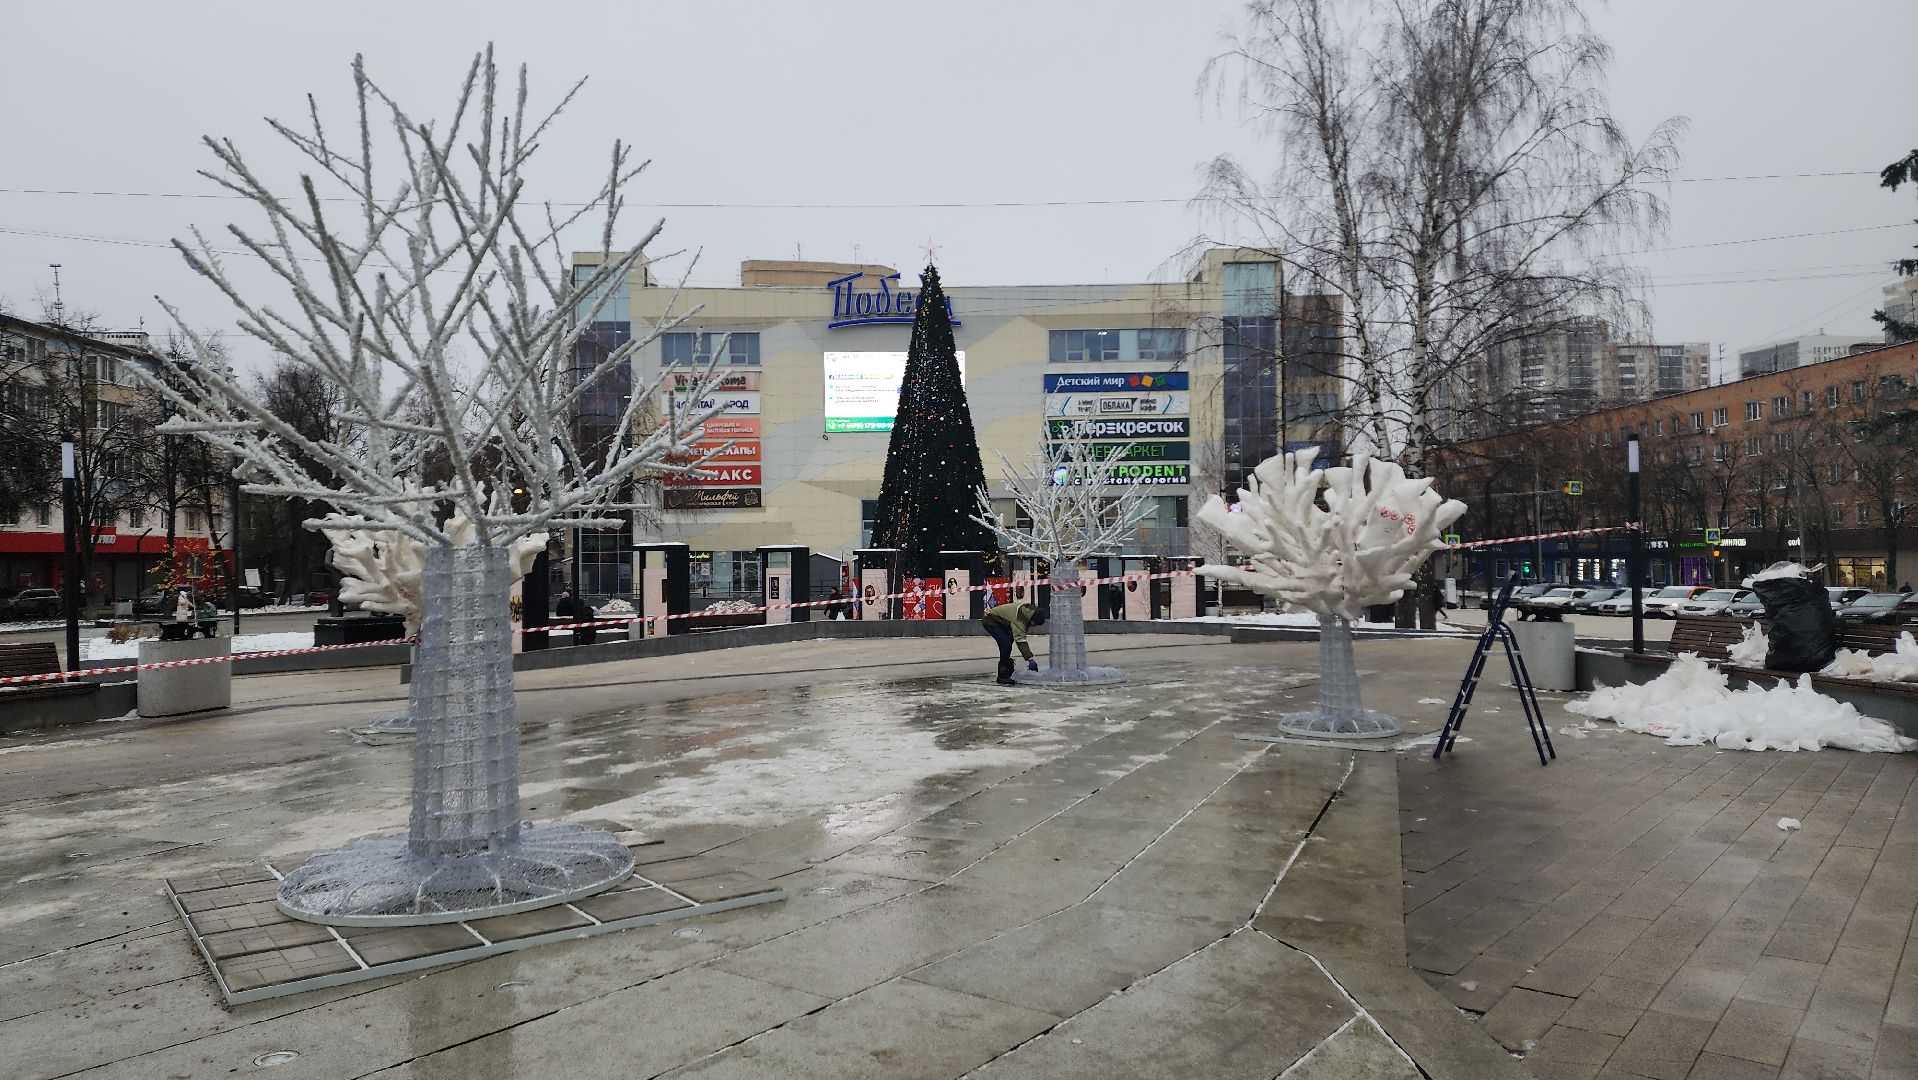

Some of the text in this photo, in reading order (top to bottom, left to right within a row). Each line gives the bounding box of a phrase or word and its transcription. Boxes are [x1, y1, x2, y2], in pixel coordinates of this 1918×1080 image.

[827, 272, 954, 318] Побе
[1057, 376, 1126, 388] Детский мир
[1102, 400, 1131, 411] ОБЛАКА
